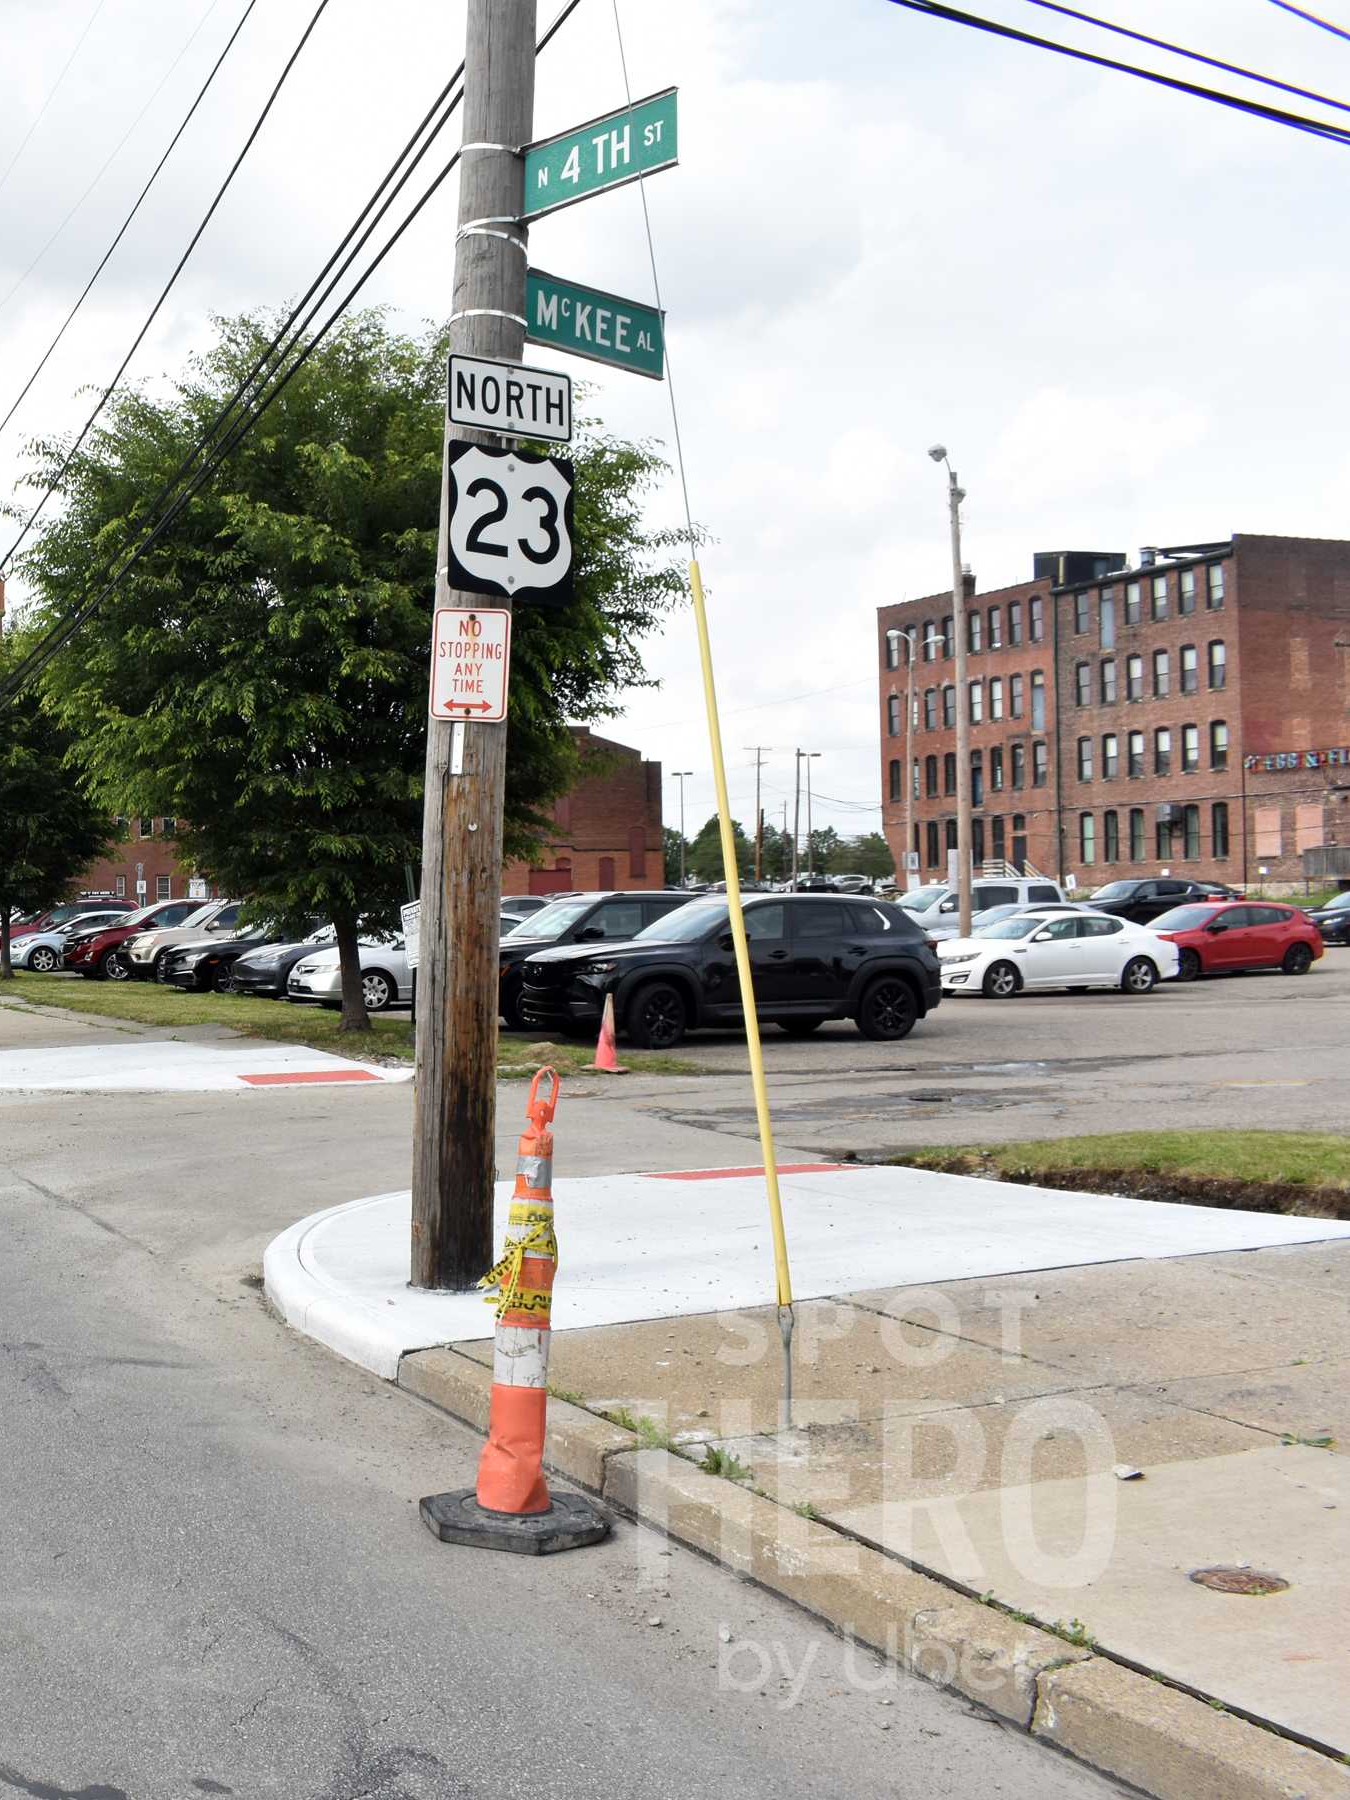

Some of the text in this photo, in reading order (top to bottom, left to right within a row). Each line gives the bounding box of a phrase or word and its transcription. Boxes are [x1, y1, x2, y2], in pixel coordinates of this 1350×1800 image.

[537, 167, 548, 188] N
[643, 120, 664, 147] ST
[636, 332, 656, 353] AL
[455, 370, 565, 426] NORTH
[465, 477, 561, 565] 23
[458, 620, 482, 637] NO
[439, 641, 502, 660] STOPPING
[454, 662, 483, 677] ANY
[452, 678, 483, 694] TIME
